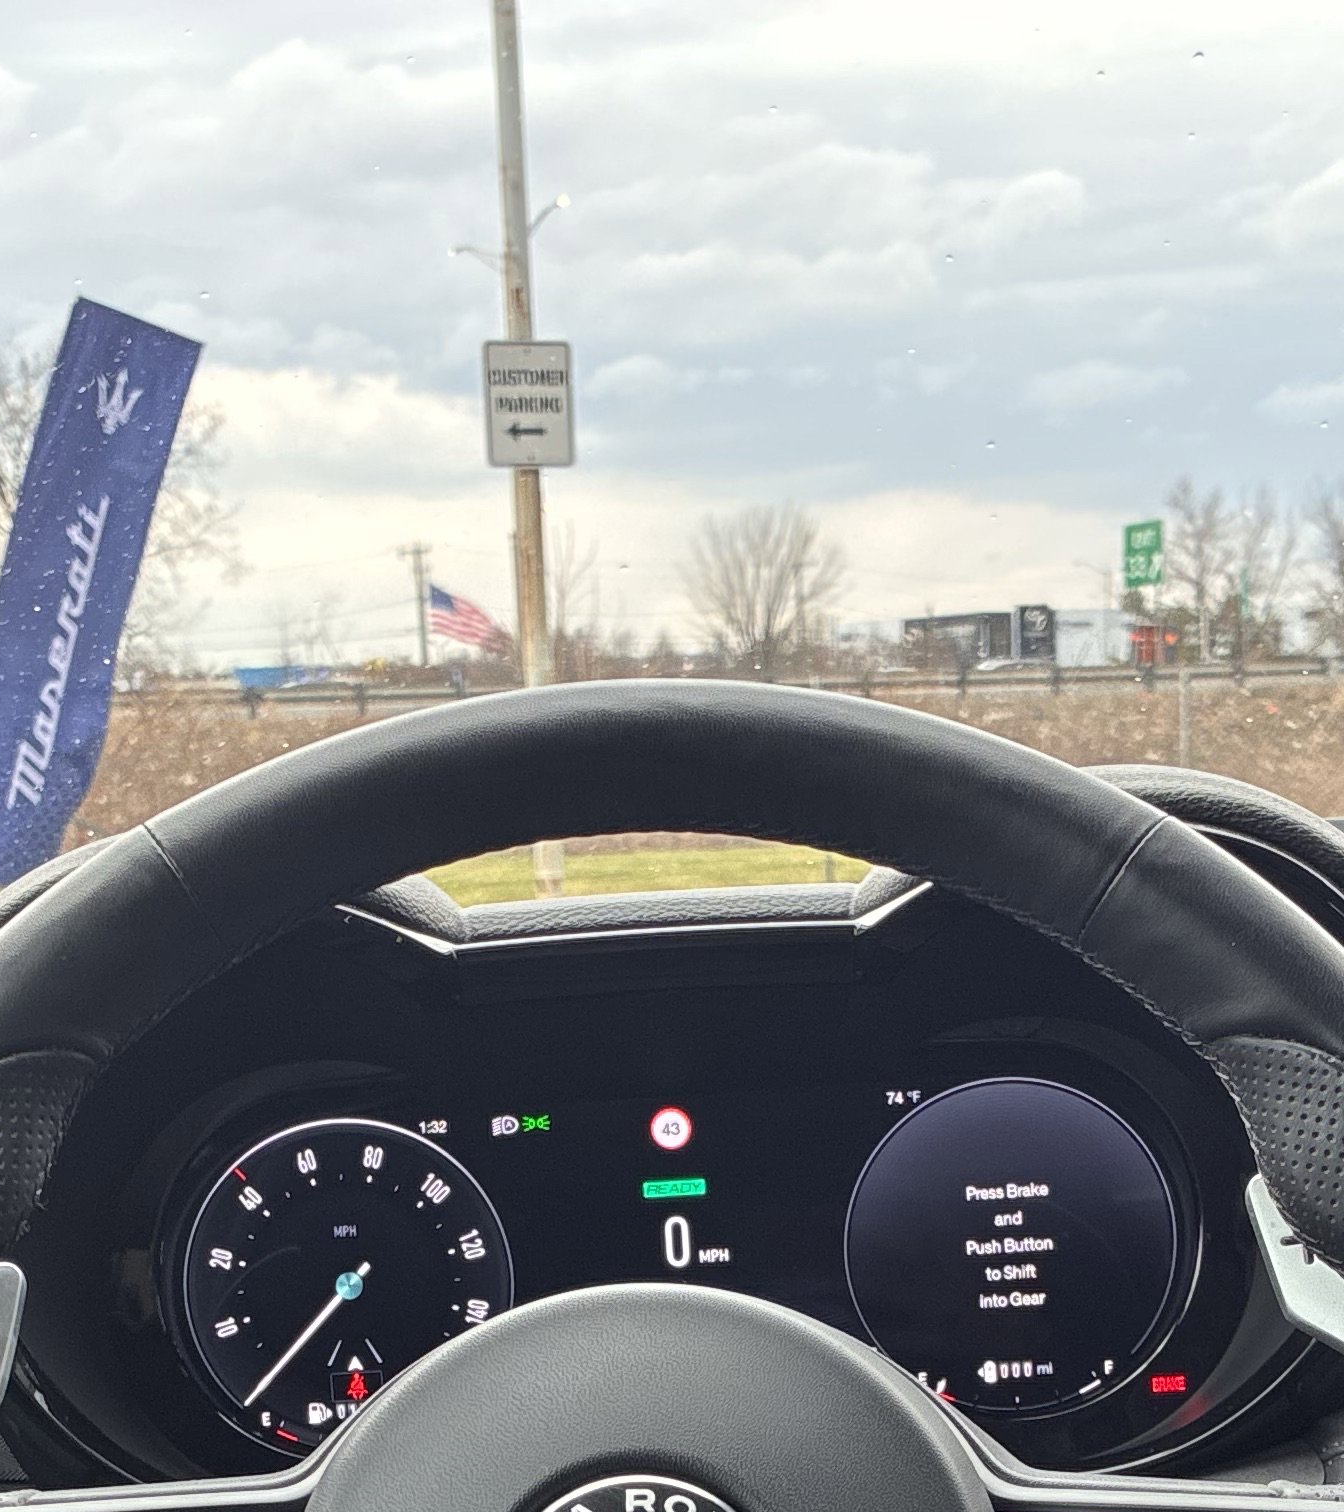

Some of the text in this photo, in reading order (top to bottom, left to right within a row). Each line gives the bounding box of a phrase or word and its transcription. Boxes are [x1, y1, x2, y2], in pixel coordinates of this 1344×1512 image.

[488, 368, 569, 386] CUSTOMER
[495, 396, 562, 413] PARKING
[6, 494, 110, 808] Maserati
[885, 1090, 904, 1106] 74
[418, 1120, 448, 1135] 1:32
[662, 1122, 681, 1137] 43
[296, 1148, 317, 1174] 60
[362, 1145, 384, 1170] 80
[420, 1172, 451, 1204] 100
[646, 1182, 702, 1196] READY
[965, 1182, 1049, 1201] Press Brake
[238, 1185, 263, 1211] 40
[994, 1210, 1023, 1226] and
[333, 1224, 357, 1239] MPH
[458, 1228, 486, 1260] 120
[664, 1215, 730, 1269] 0 MPH
[965, 1237, 1054, 1256] Push Button
[208, 1247, 233, 1271] 20
[985, 1263, 1037, 1281] to Shift
[1009, 1291, 1047, 1307] Gear
[214, 1316, 239, 1338] 10
[1104, 1360, 1114, 1375] F
[1152, 1376, 1186, 1392] BRAKE
[261, 1411, 272, 1427] E
